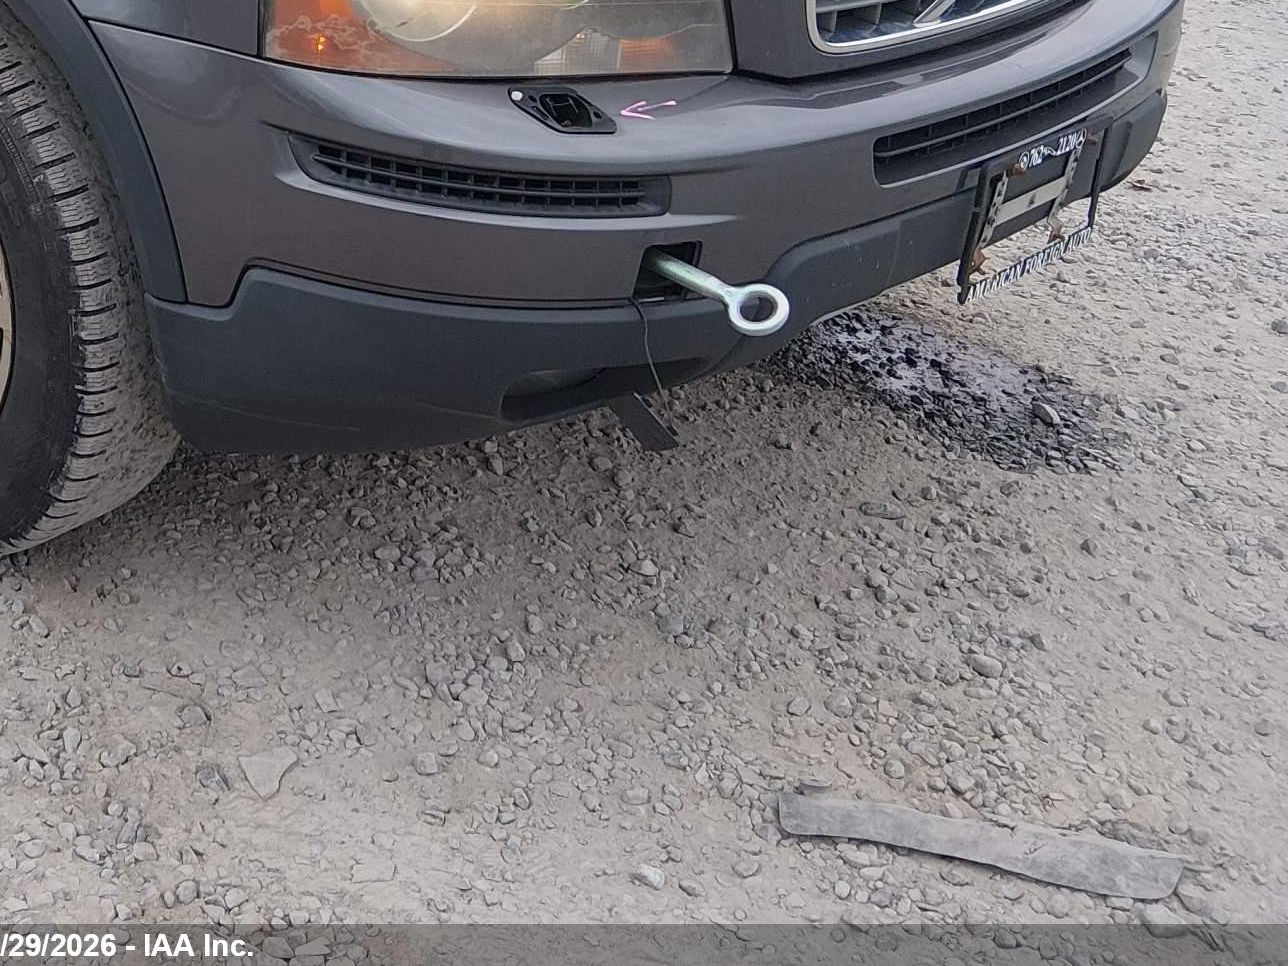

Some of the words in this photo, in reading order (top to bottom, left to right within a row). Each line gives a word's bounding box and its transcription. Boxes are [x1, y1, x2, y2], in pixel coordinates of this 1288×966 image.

[966, 260, 1025, 303] AMERICAN
[1025, 241, 1065, 274] FOREIGN
[1066, 226, 1093, 251] AUTO
